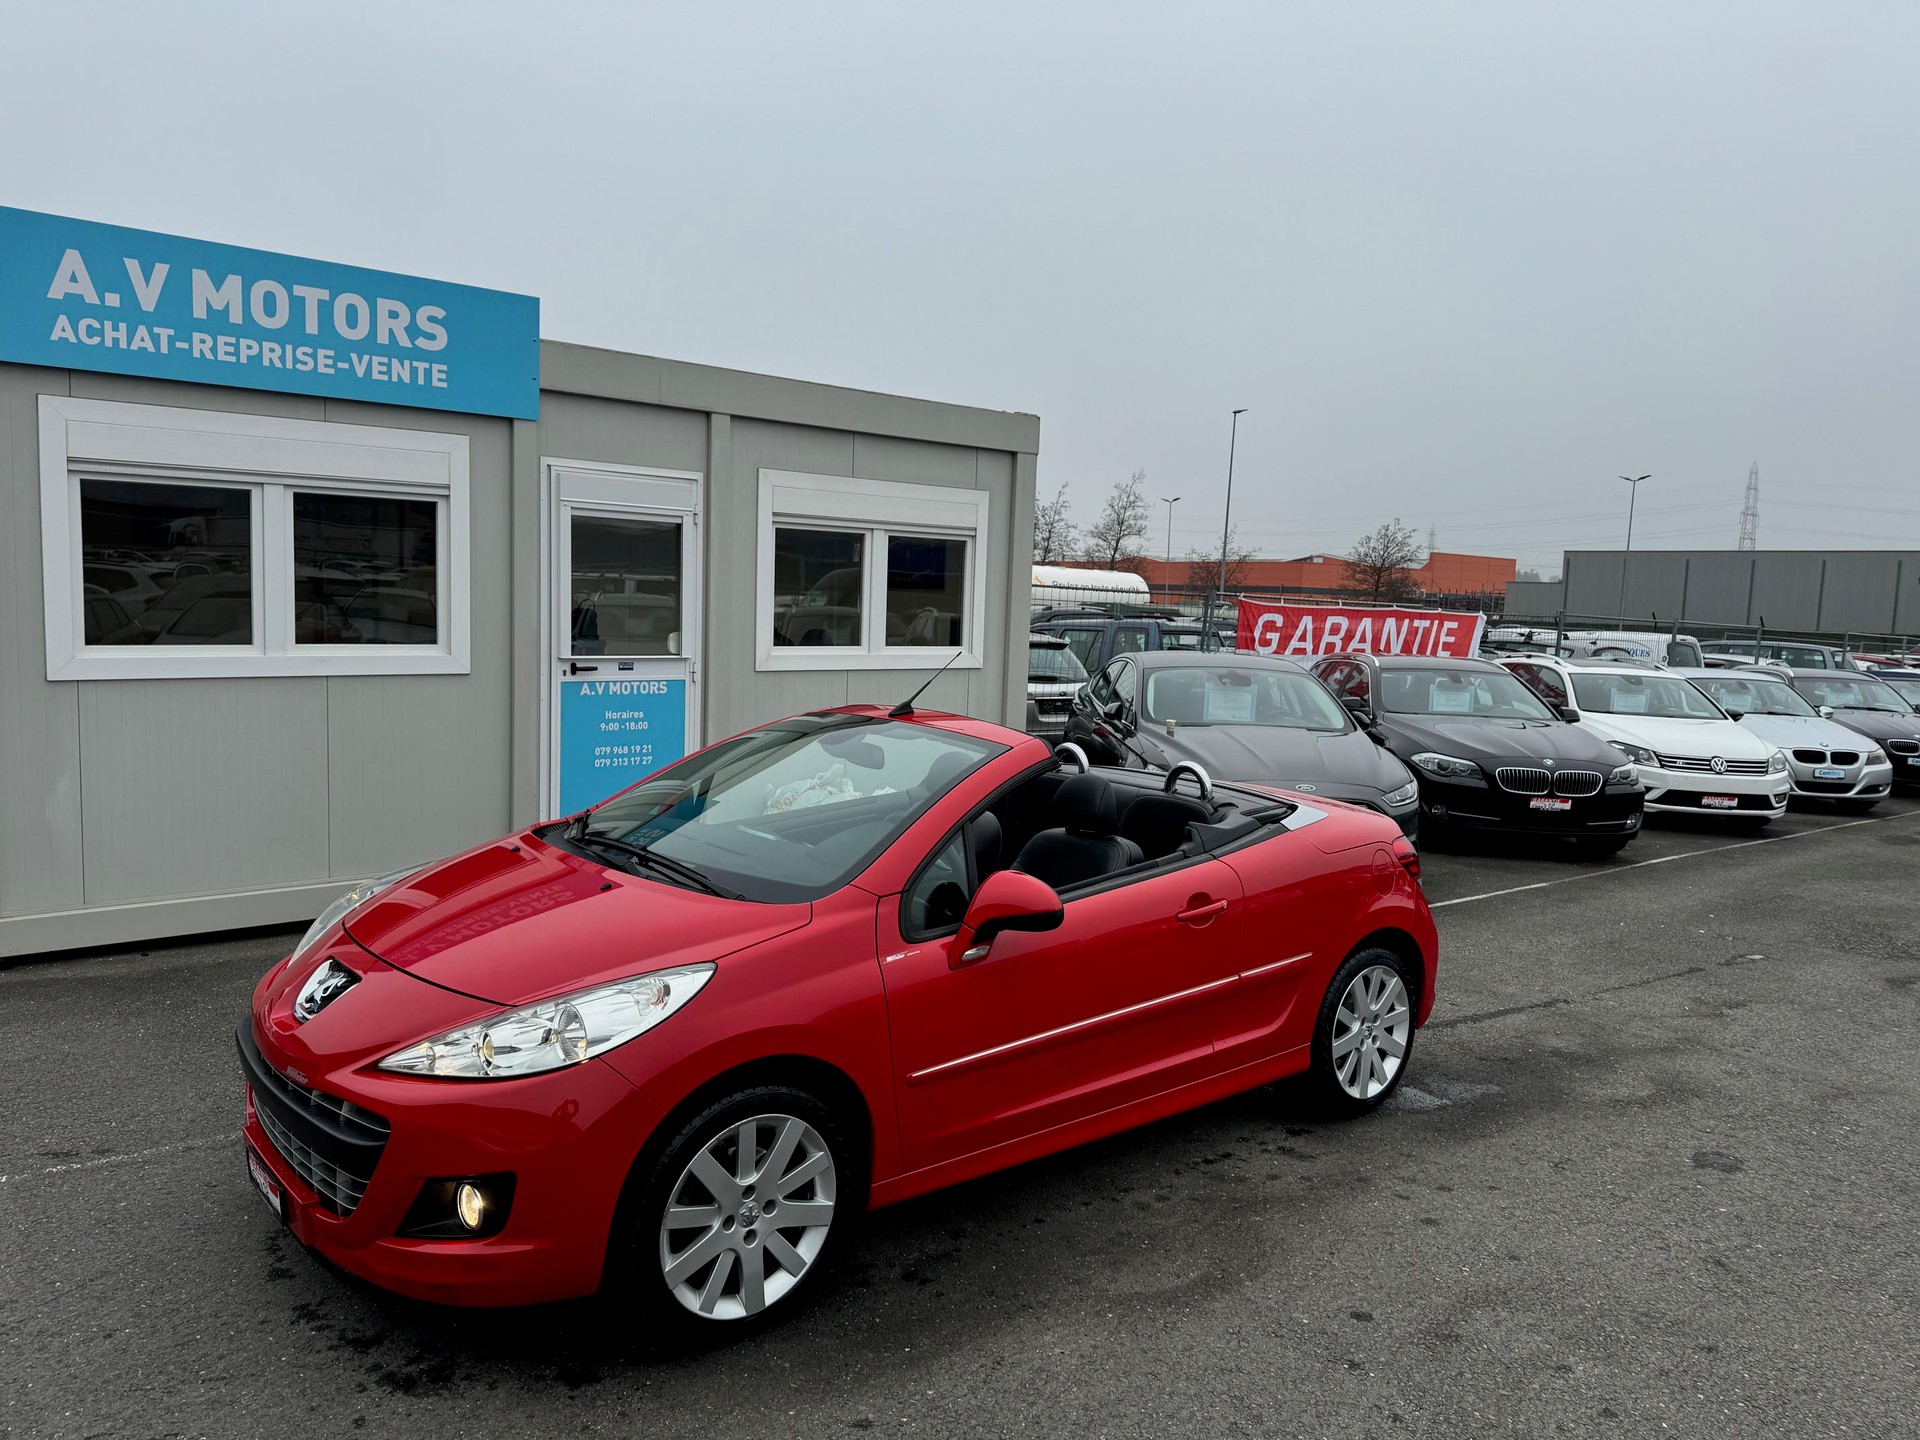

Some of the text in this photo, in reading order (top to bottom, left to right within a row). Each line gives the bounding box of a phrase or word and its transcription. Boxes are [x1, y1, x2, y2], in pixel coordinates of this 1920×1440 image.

[47, 248, 448, 352] A.V MOTORS
[50, 314, 448, 388] ACHAT-REPRISE-VENTE
[1253, 612, 1459, 657] GARANTIE
[580, 681, 667, 695] A.V MOTORS
[605, 710, 644, 719] Horaires
[600, 722, 619, 731] 9:00
[595, 745, 652, 755] 079 968 19 21
[595, 756, 652, 767] 079 313 17 27
